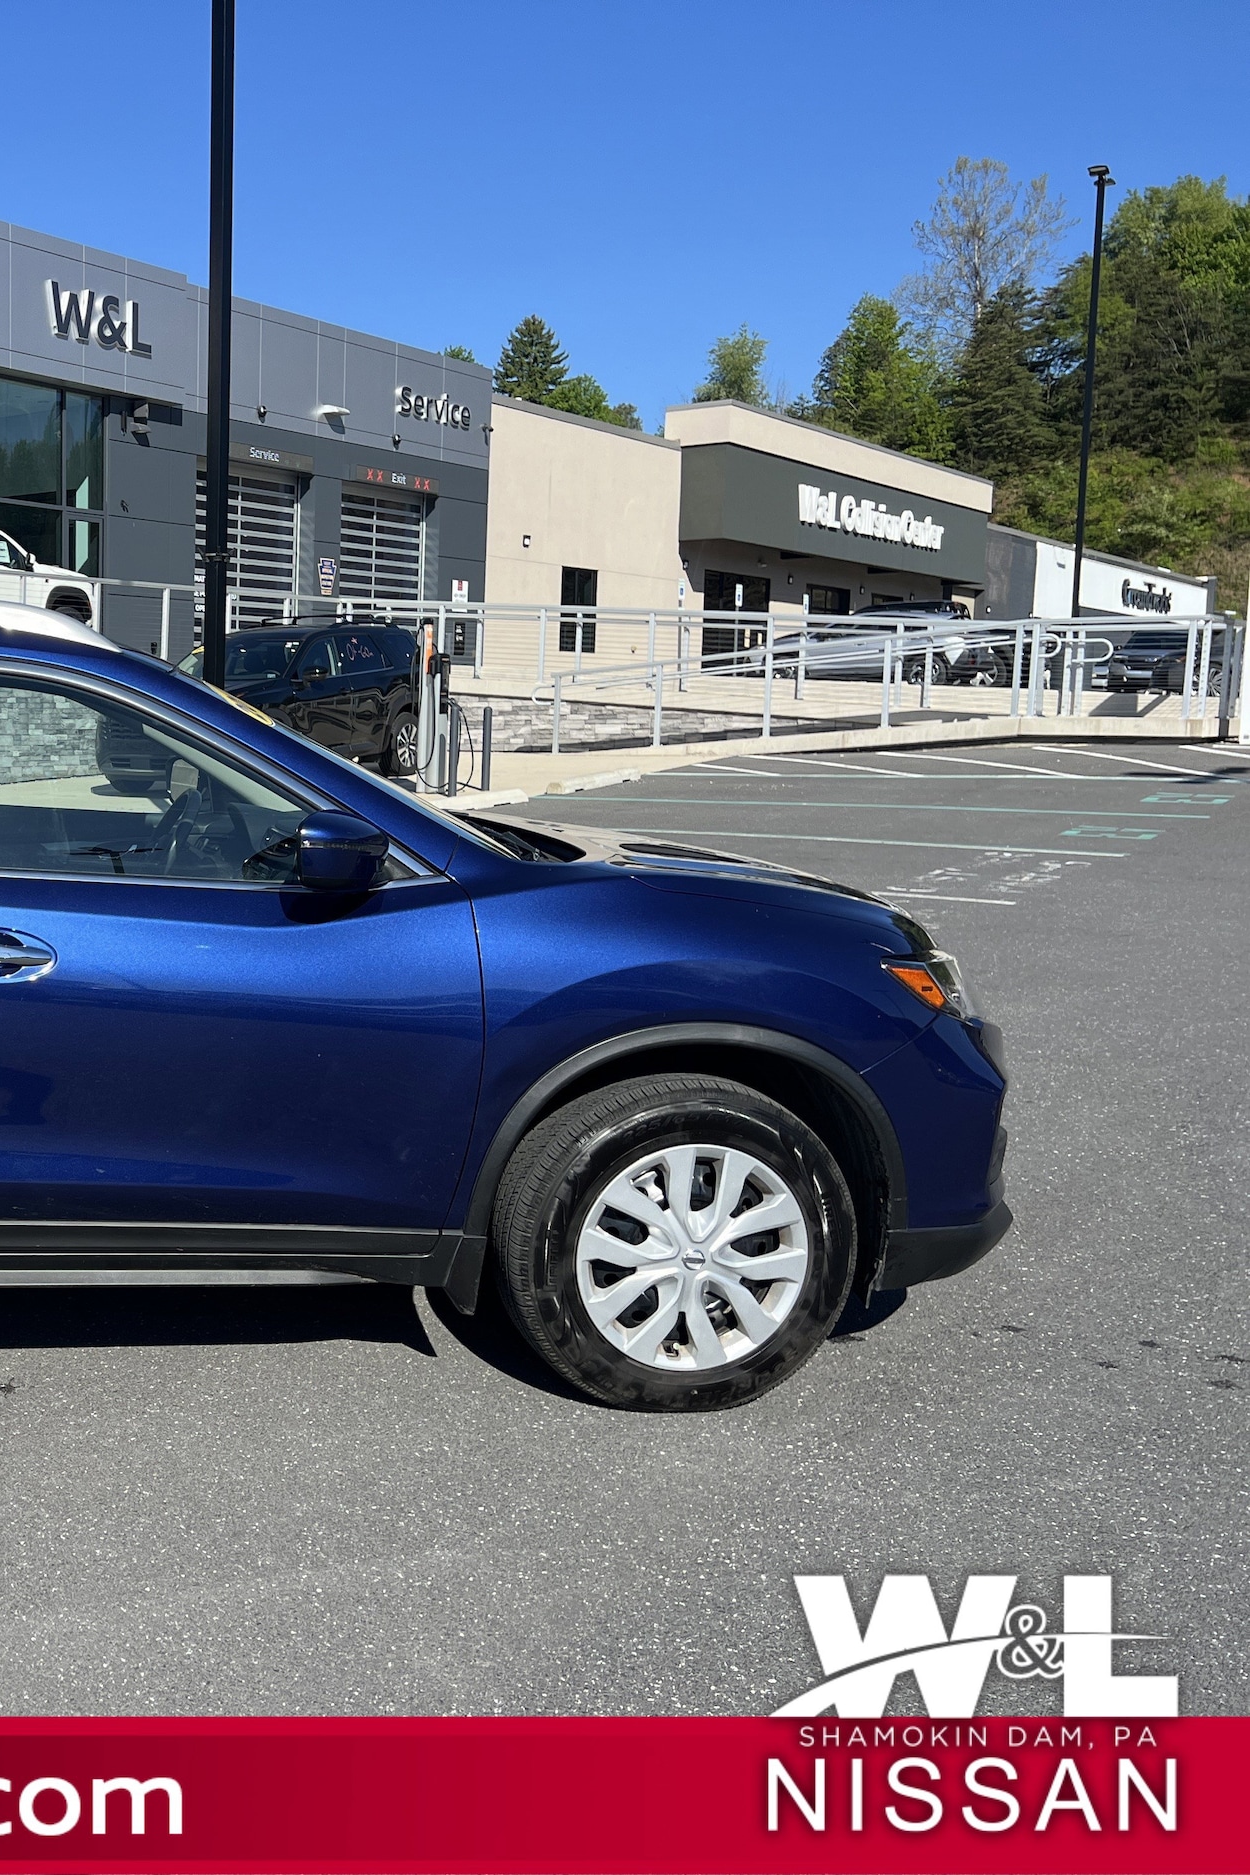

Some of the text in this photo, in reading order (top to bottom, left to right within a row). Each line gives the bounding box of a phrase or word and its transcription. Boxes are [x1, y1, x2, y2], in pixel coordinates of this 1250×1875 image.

[45, 279, 152, 360] W&L
[395, 386, 471, 431] Service
[249, 446, 280, 462] Service
[391, 472, 407, 485] Exit
[798, 484, 945, 552] W&L Collision Center
